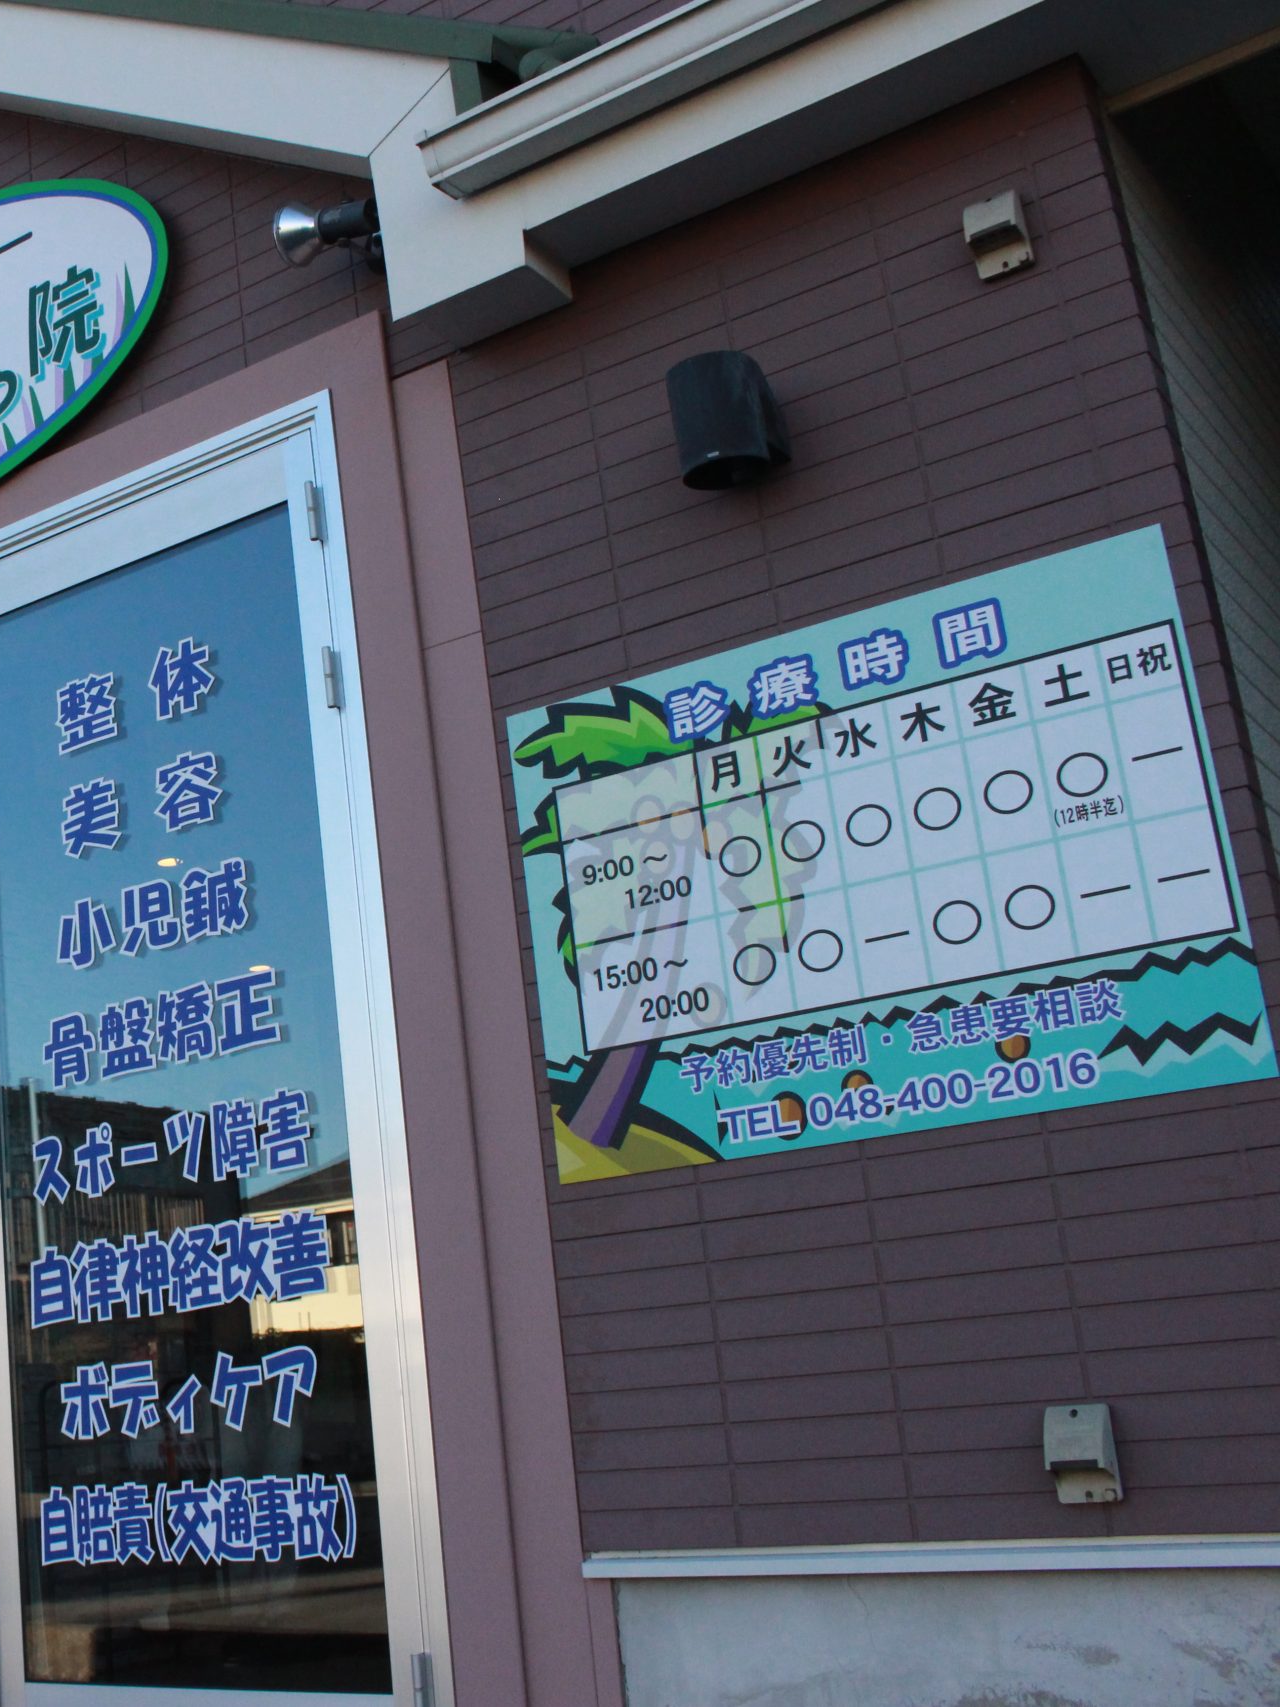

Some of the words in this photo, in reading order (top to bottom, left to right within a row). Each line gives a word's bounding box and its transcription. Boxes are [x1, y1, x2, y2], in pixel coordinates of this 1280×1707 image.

[28, 264, 105, 381] 院
[55, 636, 215, 755] 整体
[665, 599, 1006, 741] 診療時間
[710, 752, 742, 793] 月
[772, 734, 813, 780] 火
[834, 718, 877, 758] 水
[900, 702, 946, 743] 木
[968, 682, 1017, 727] 金
[1044, 664, 1090, 708] 土
[1106, 643, 1173, 685] 日祝
[62, 751, 223, 859] 美容
[1053, 795, 1126, 828] (12時半迄)
[56, 857, 249, 970] 小児鍼
[624, 875, 693, 911] 12:00
[44, 968, 281, 1089] 骨盤矯正
[639, 986, 710, 1023] 20:00
[680, 977, 1125, 1094] 予約優先制・急患要相談
[32, 1089, 311, 1205] スポーツ障害
[720, 1104, 801, 1145] TEL
[808, 1050, 1100, 1129] 048-400-2016
[30, 1209, 330, 1329] 自律神経改善
[60, 1346, 318, 1440] ボディケア
[40, 1473, 358, 1567] 自賠責(交通事故)
